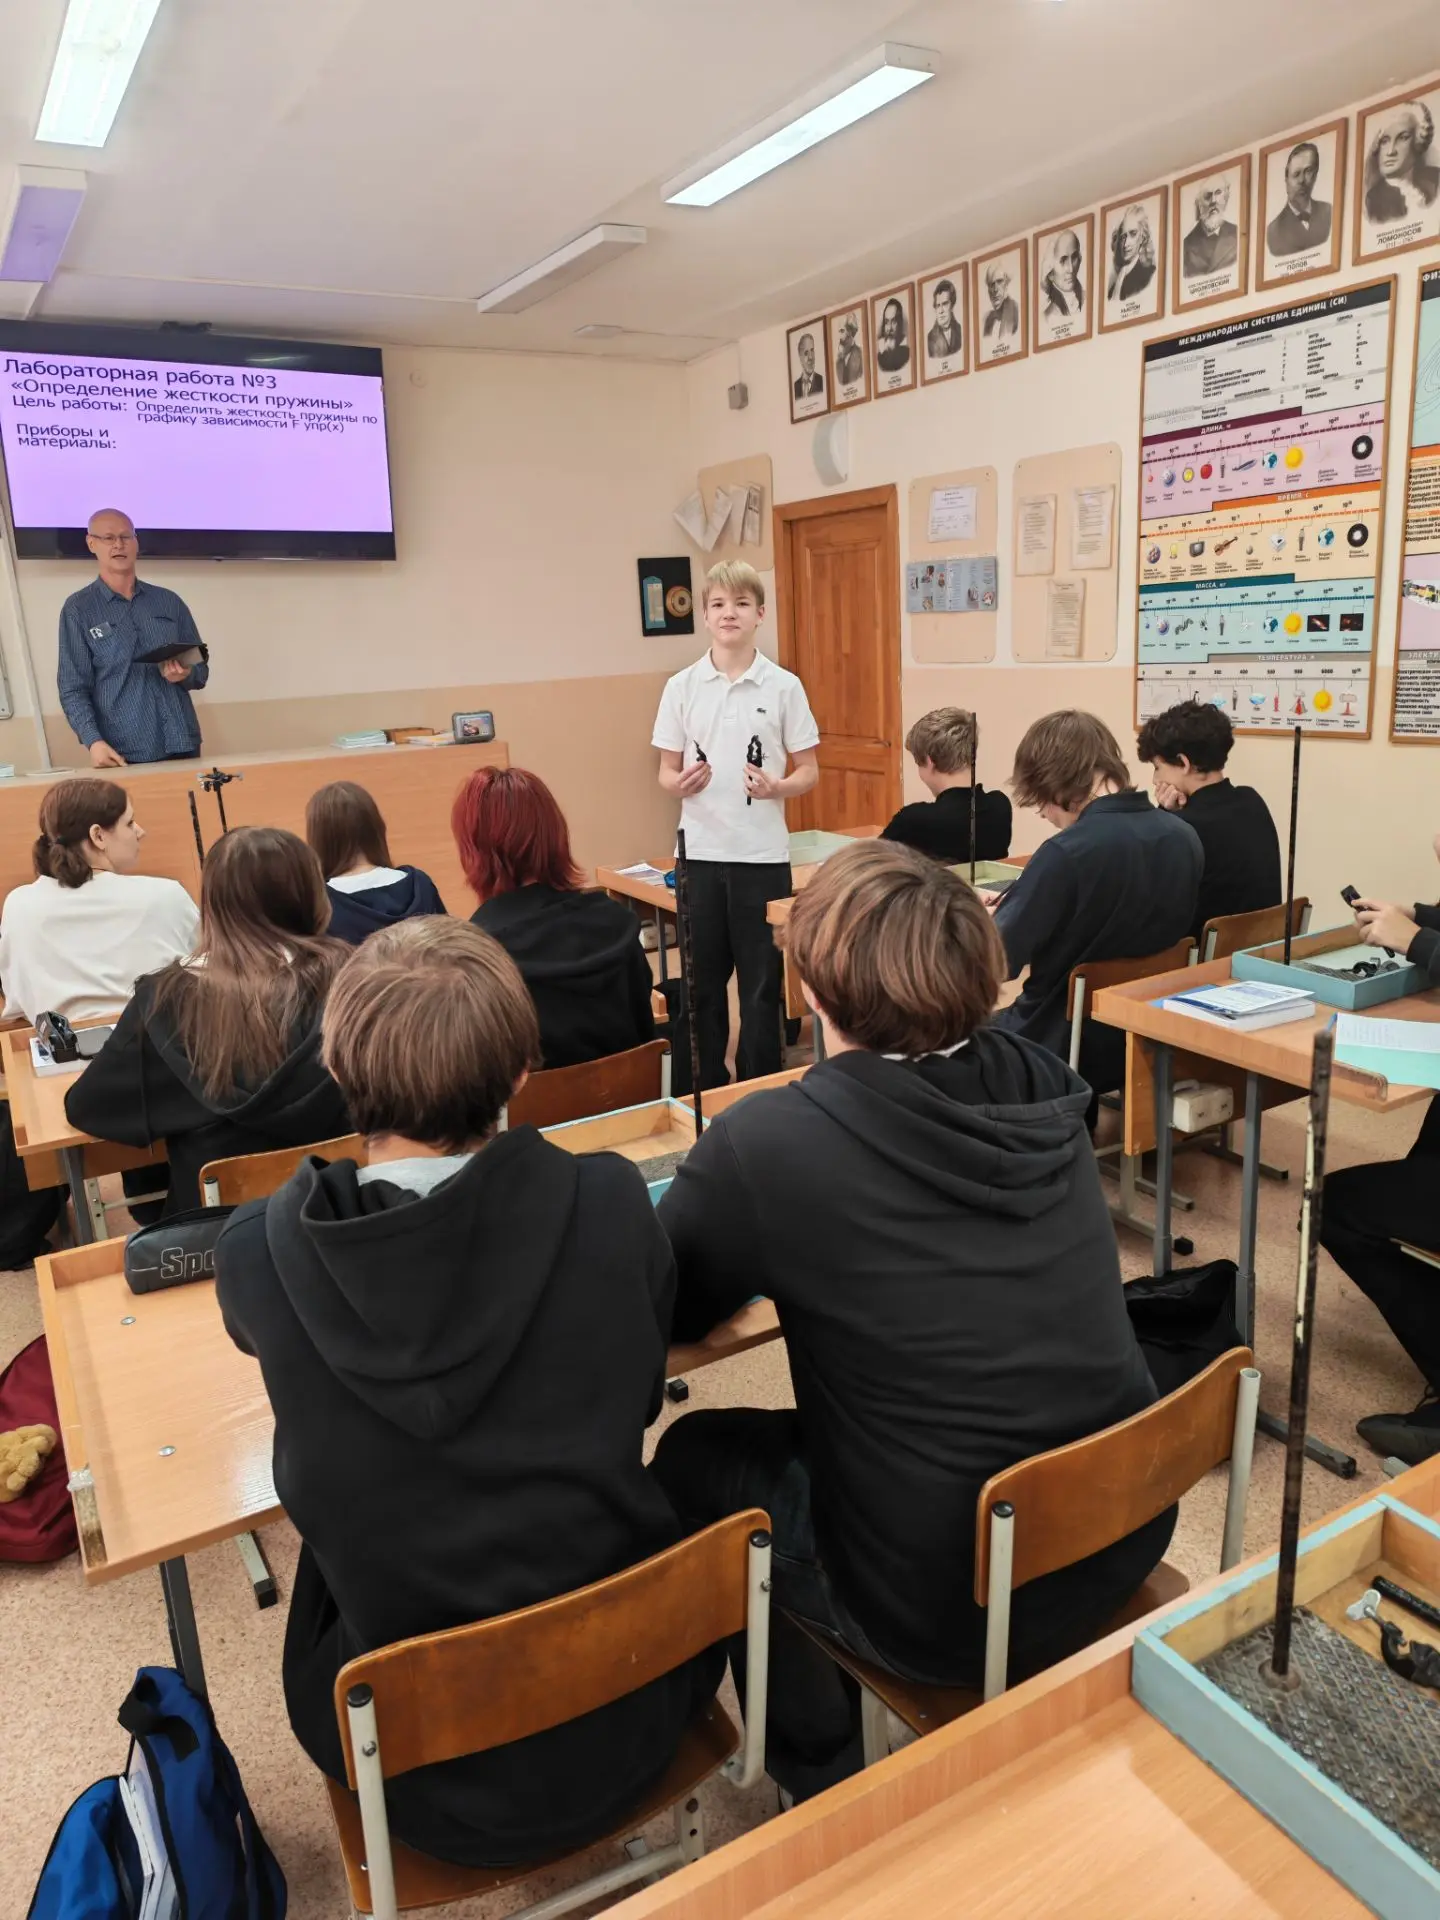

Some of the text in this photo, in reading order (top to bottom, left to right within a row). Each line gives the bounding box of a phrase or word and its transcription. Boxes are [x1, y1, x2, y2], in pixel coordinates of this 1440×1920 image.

[1378, 227, 1422, 245] ЛОМОНОСОВ
[1286, 260, 1308, 270] ПОПОВ
[1190, 278, 1230, 294] ЦИОЛКОВСКИЙ
[1178, 322, 1248, 346] МЕЖДУНАРОДНАЯ
[1251, 312, 1288, 326] СИСТЕМА
[1290, 301, 1327, 317] ЕДИНИЦ
[1330, 295, 1348, 308] (СИ)
[4, 359, 277, 388] Лабораторная работа №3
[11, 379, 353, 409] «Определение жесткости пружины»
[13, 395, 128, 411] Цель работы:
[136, 401, 378, 424] Определить жесткость пружины по
[138, 413, 197, 426] графику
[202, 416, 288, 428] зависимости
[292, 420, 300, 430] F
[16, 423, 108, 438] Приборы и
[18, 437, 116, 449] материалы:
